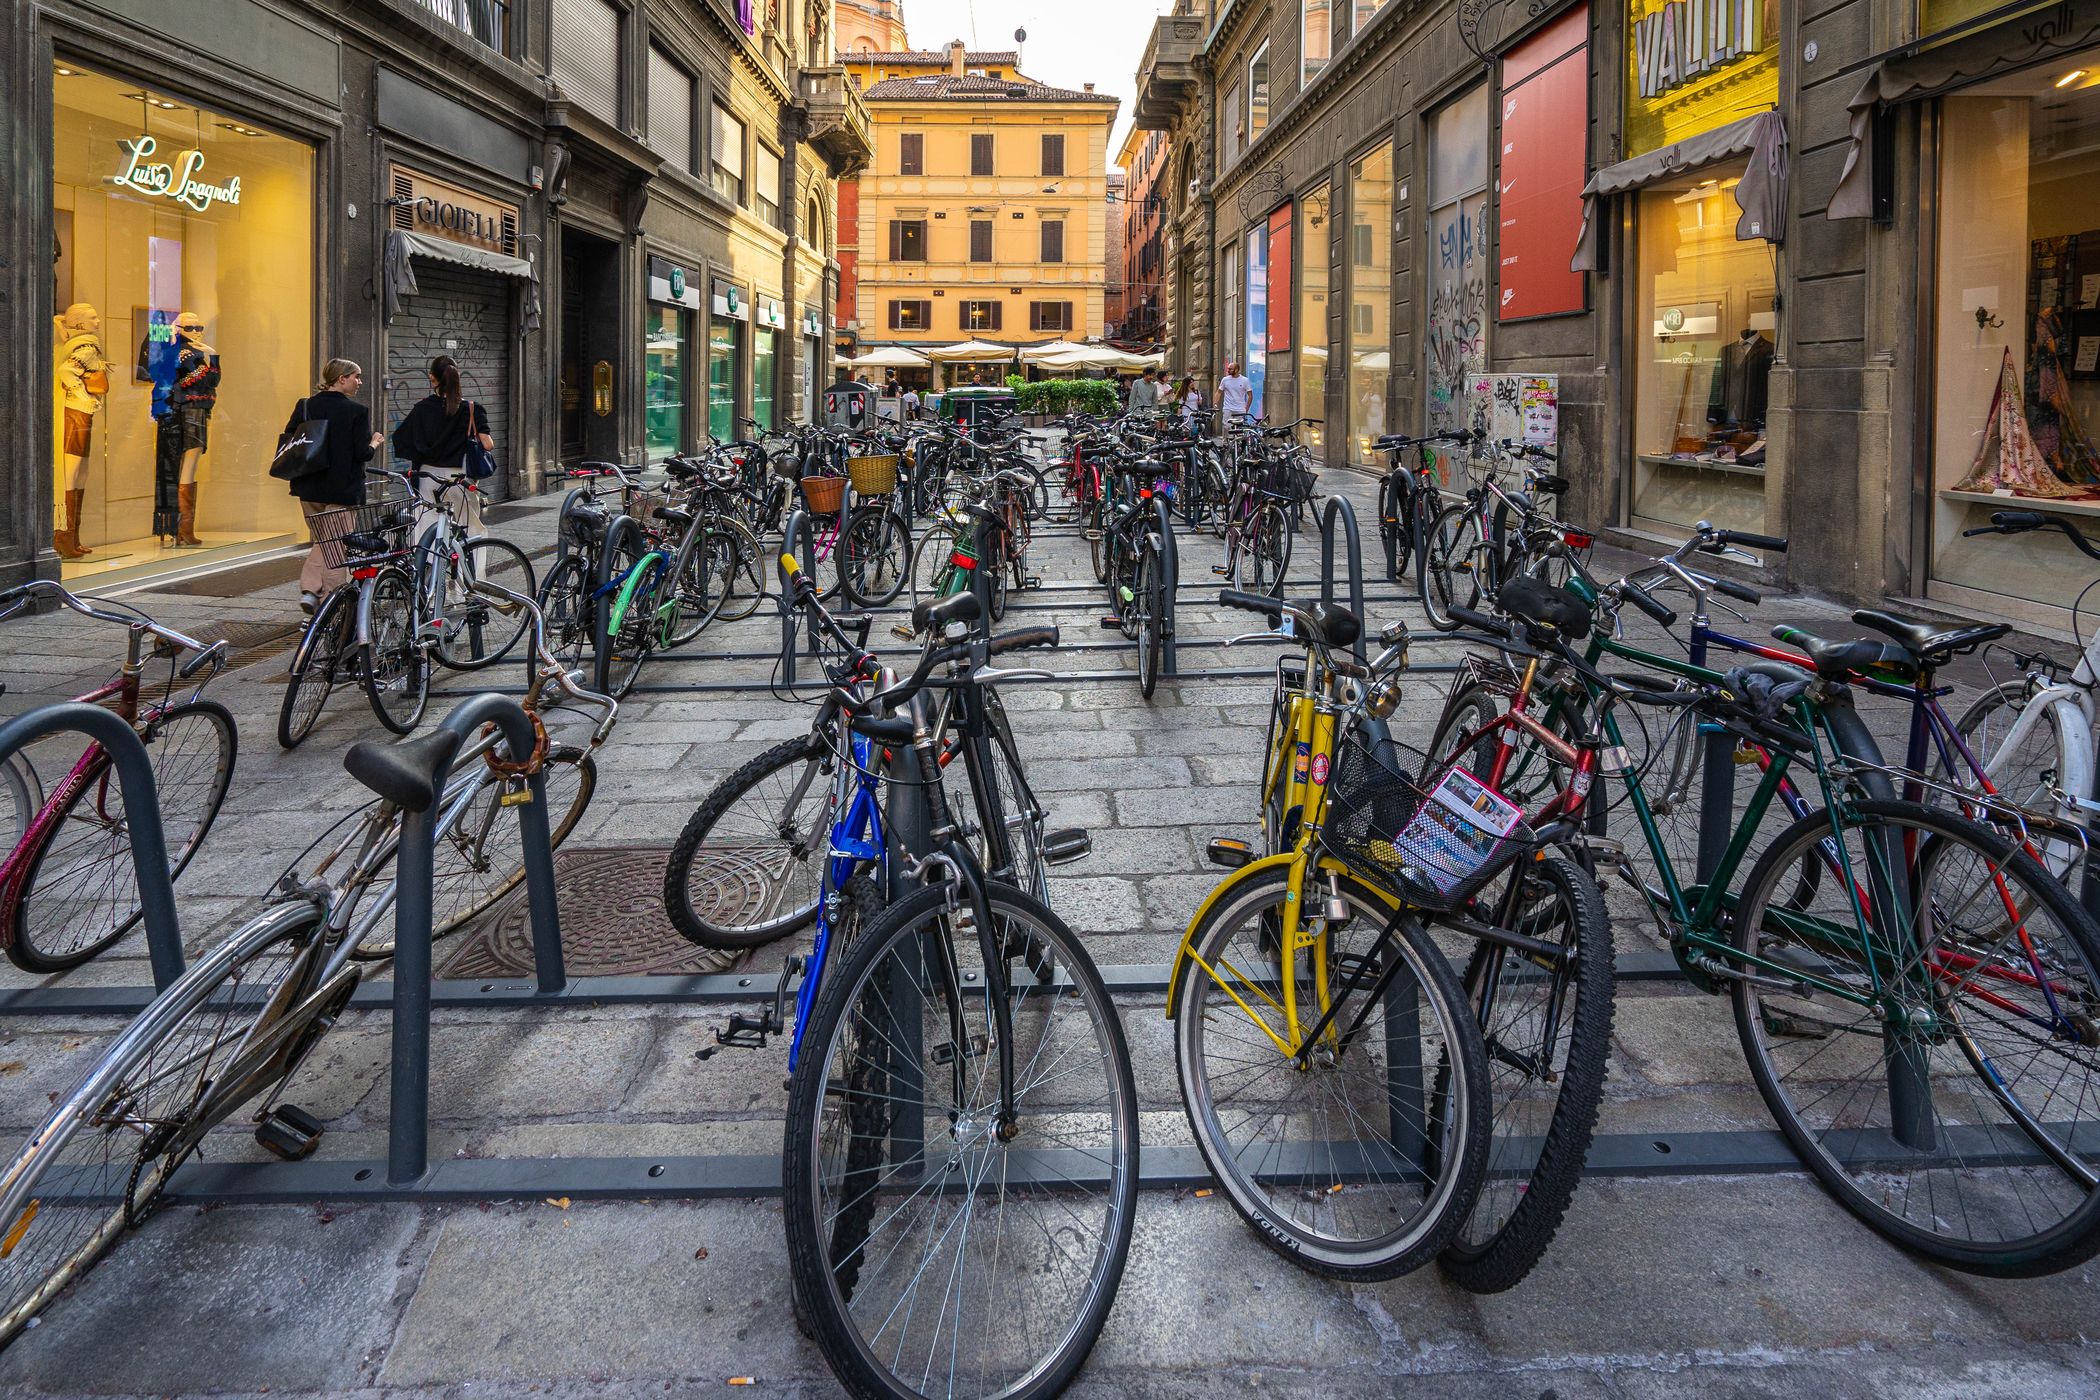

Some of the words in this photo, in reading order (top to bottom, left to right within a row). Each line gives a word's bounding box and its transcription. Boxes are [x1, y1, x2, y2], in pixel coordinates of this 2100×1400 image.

[2022, 4, 2074, 46] valli
[1635, 0, 1763, 97] VALLI
[1660, 145, 1681, 168] valli
[166, 151, 241, 212] Spagnoli
[1253, 1212, 1300, 1249] KENDA
